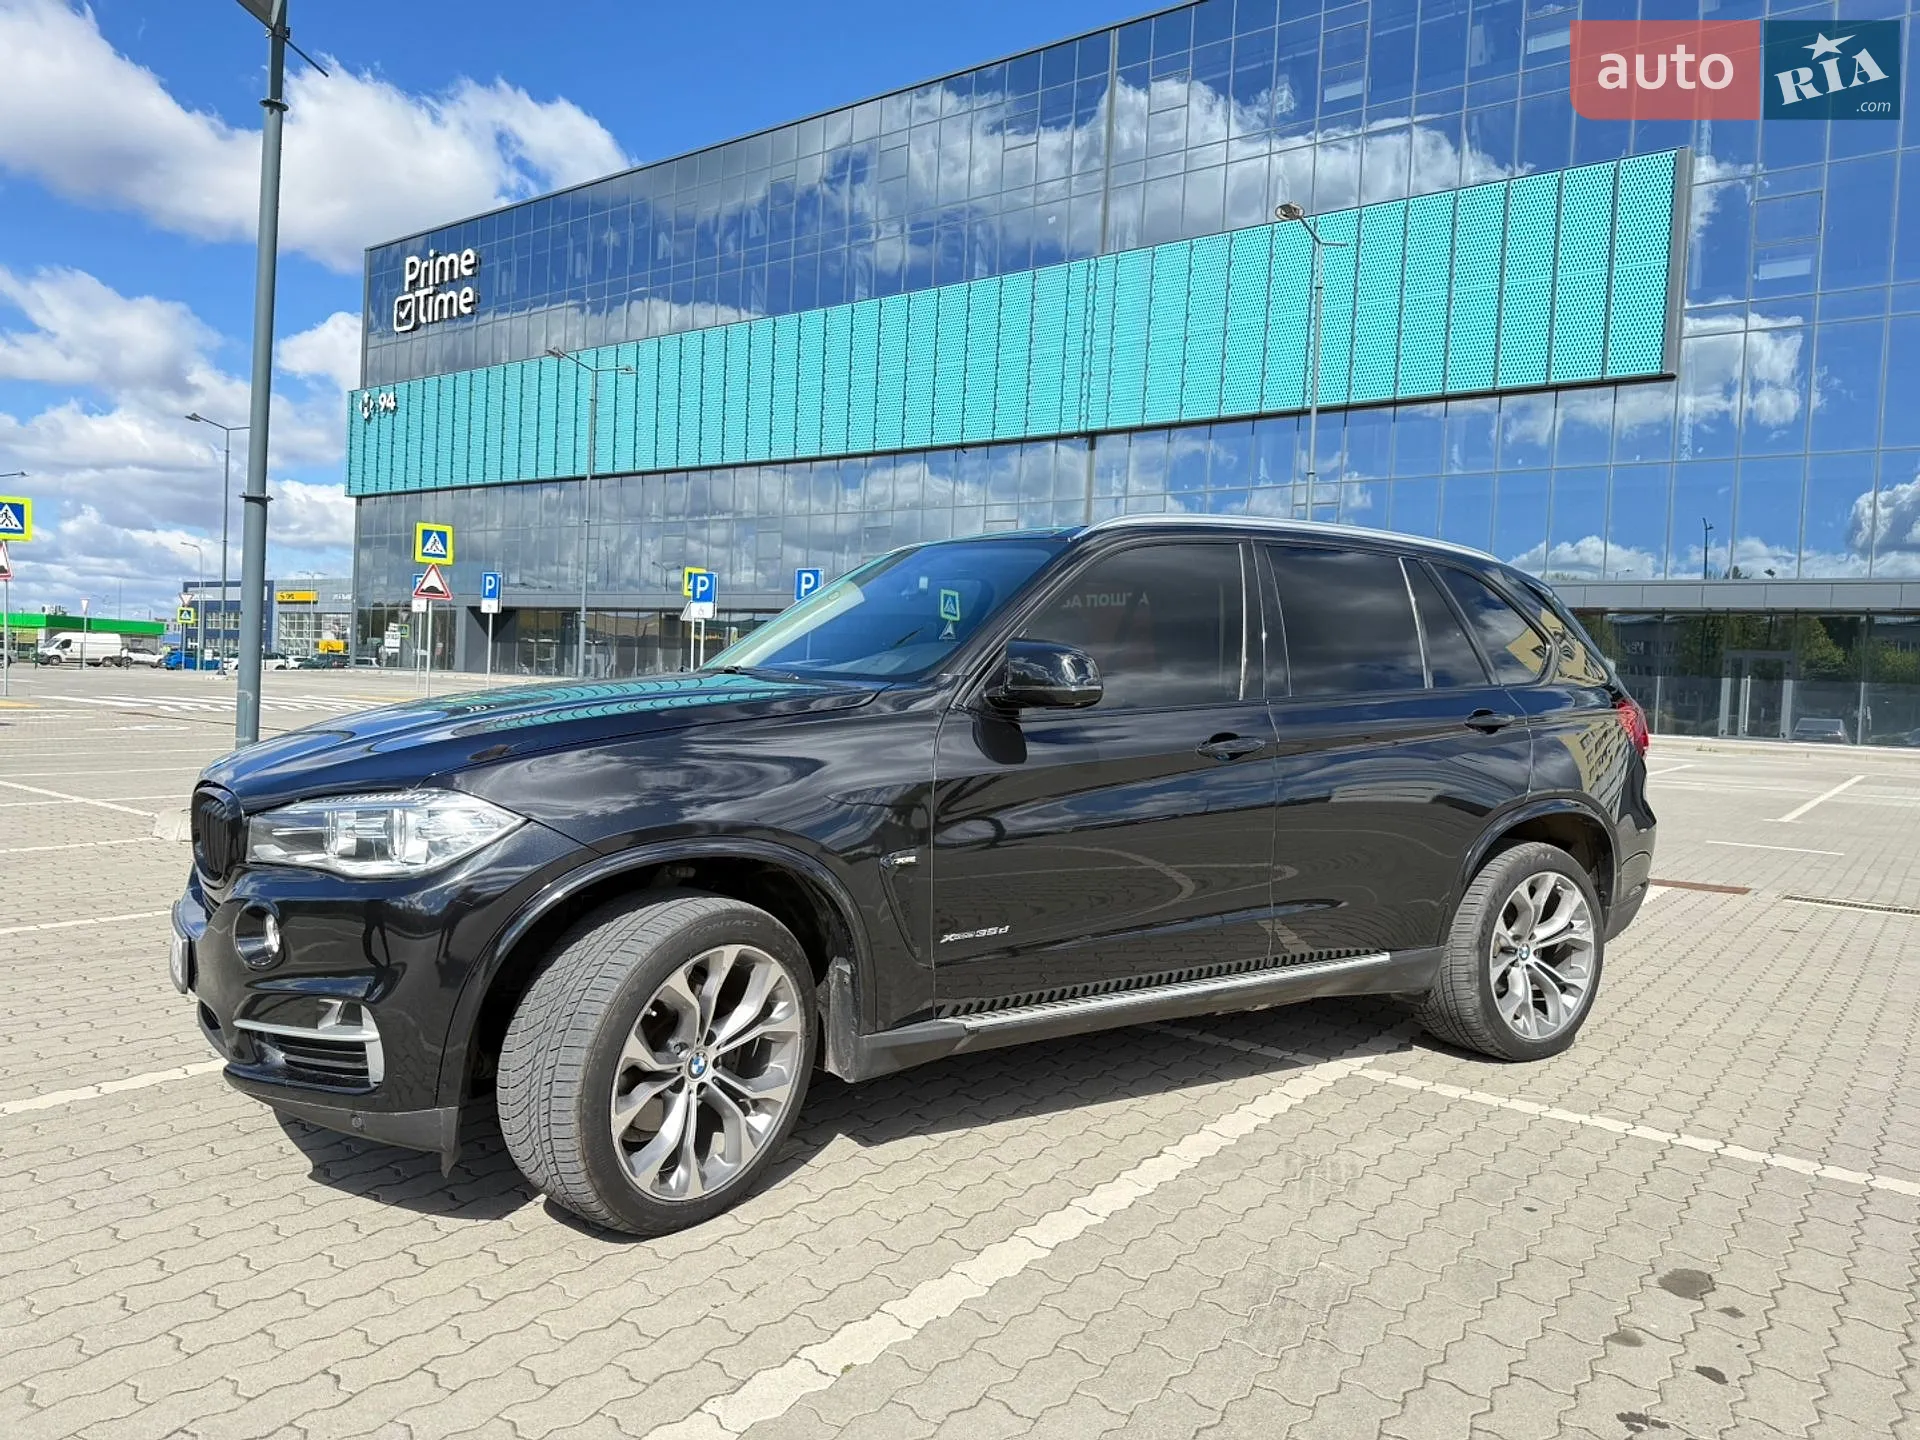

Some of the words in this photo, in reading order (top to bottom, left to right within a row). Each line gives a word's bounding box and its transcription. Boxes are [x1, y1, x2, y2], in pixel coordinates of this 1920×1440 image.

[404, 248, 475, 291] Prime
[415, 286, 474, 323] Time
[378, 392, 396, 411] 94
[485, 575, 495, 596] P
[696, 575, 710, 599] P
[800, 572, 815, 597] P
